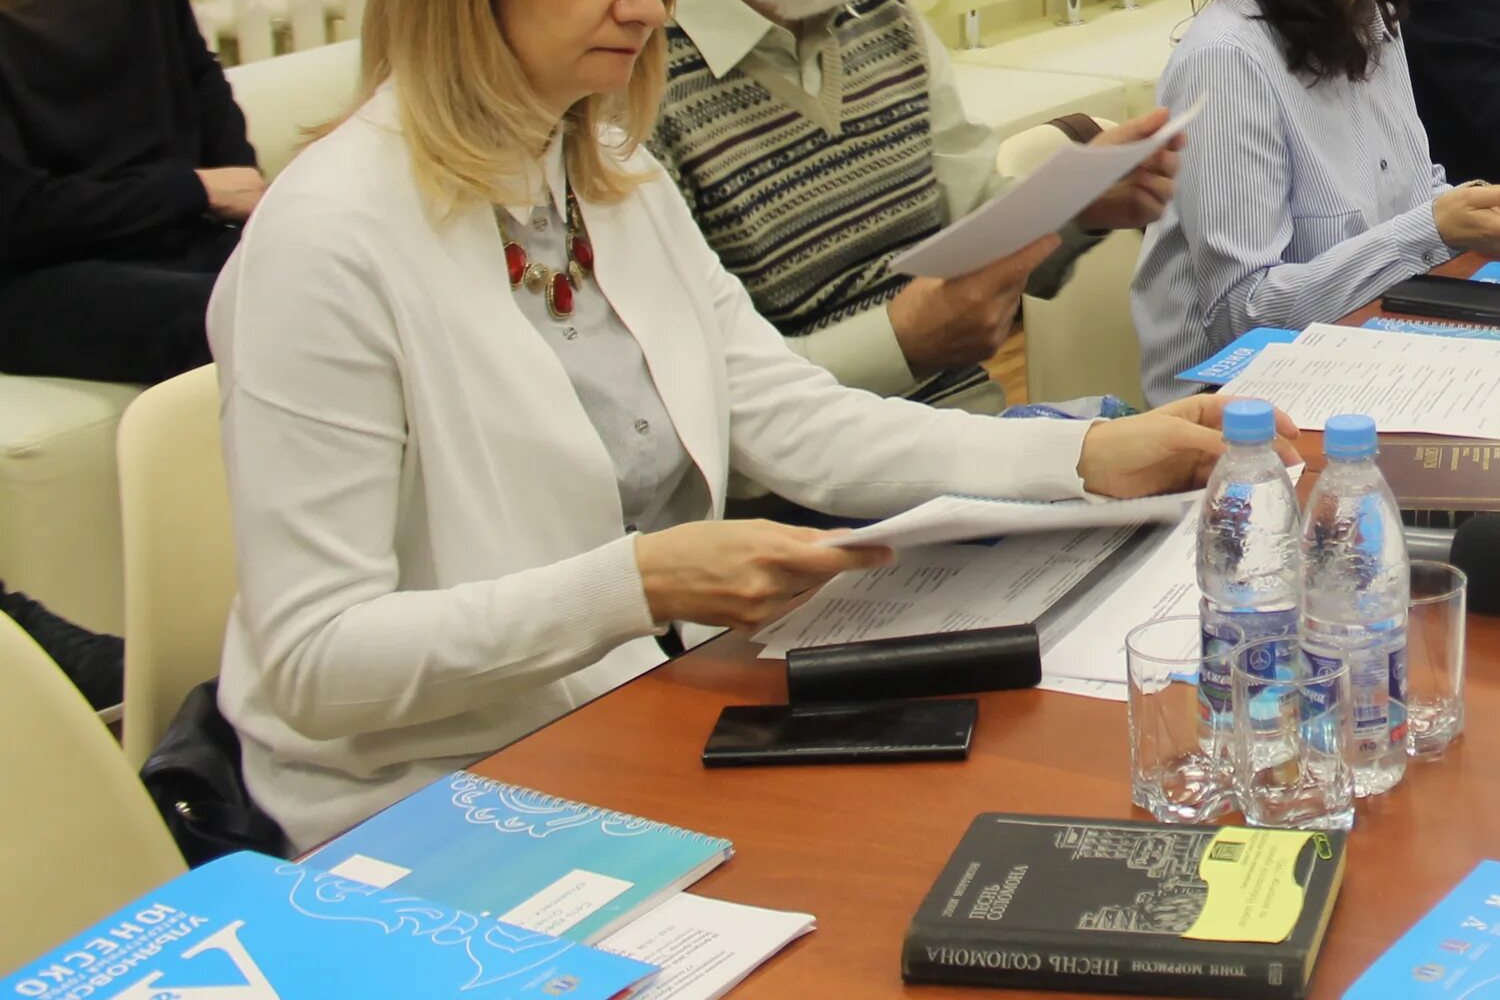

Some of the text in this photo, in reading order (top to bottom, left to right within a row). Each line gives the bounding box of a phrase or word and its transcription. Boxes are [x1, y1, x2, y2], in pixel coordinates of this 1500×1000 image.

[968, 884, 1001, 920] ПЕСНЬ
[986, 864, 1029, 921] СОЛОМОНА
[14, 902, 177, 997] ЮНЕСКО
[925, 946, 1042, 971] СОЛОМОНА
[1048, 955, 1119, 977] ПЕСНЬ
[1131, 960, 1204, 976] МОРРИСОН
